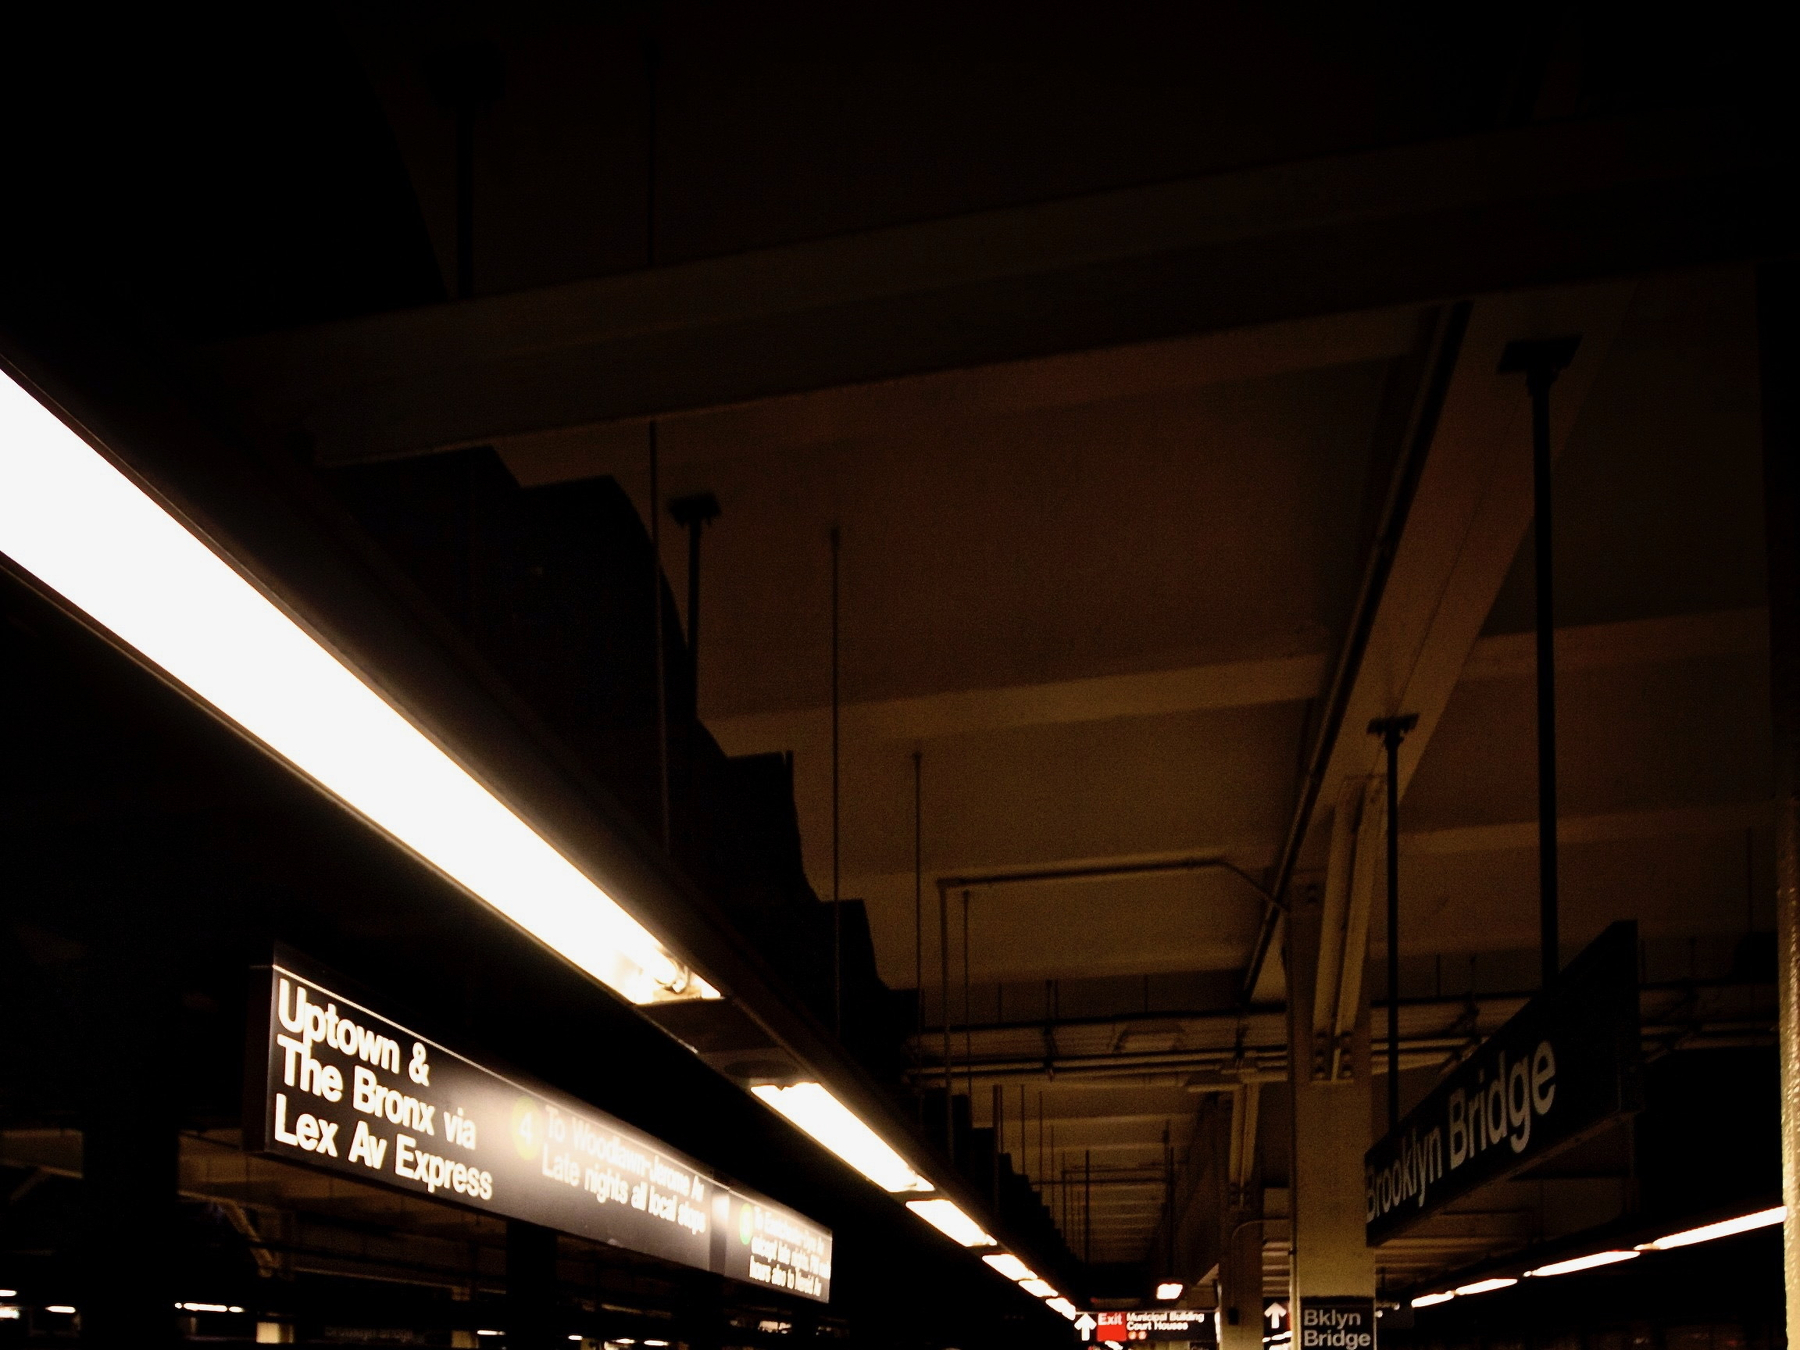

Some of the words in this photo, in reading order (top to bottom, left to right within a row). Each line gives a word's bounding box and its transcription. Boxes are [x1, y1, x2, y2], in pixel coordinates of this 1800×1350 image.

[278, 978, 400, 1074] Uptown
[408, 1041, 430, 1086] &
[277, 1034, 344, 1102] The
[353, 1065, 435, 1136] Bronx
[443, 1107, 477, 1150] via
[275, 1093, 338, 1158] Lex
[348, 1120, 387, 1170] Av
[395, 1133, 493, 1201] Express
[518, 1112, 533, 1145] 4
[545, 1104, 566, 1142] To
[1366, 1124, 1442, 1224] Brooklyn
[1450, 1040, 1556, 1170] Bridge
[542, 1143, 581, 1187] Late
[584, 1162, 629, 1204] nights
[631, 1181, 649, 1211] all
[648, 1185, 678, 1222] local
[1098, 1312, 1123, 1325] Exit
[1126, 1321, 1151, 1331] Court
[1154, 1321, 1189, 1330] Houses
[1304, 1309, 1361, 1329] Bklyn
[1304, 1329, 1371, 1350] Bridge
